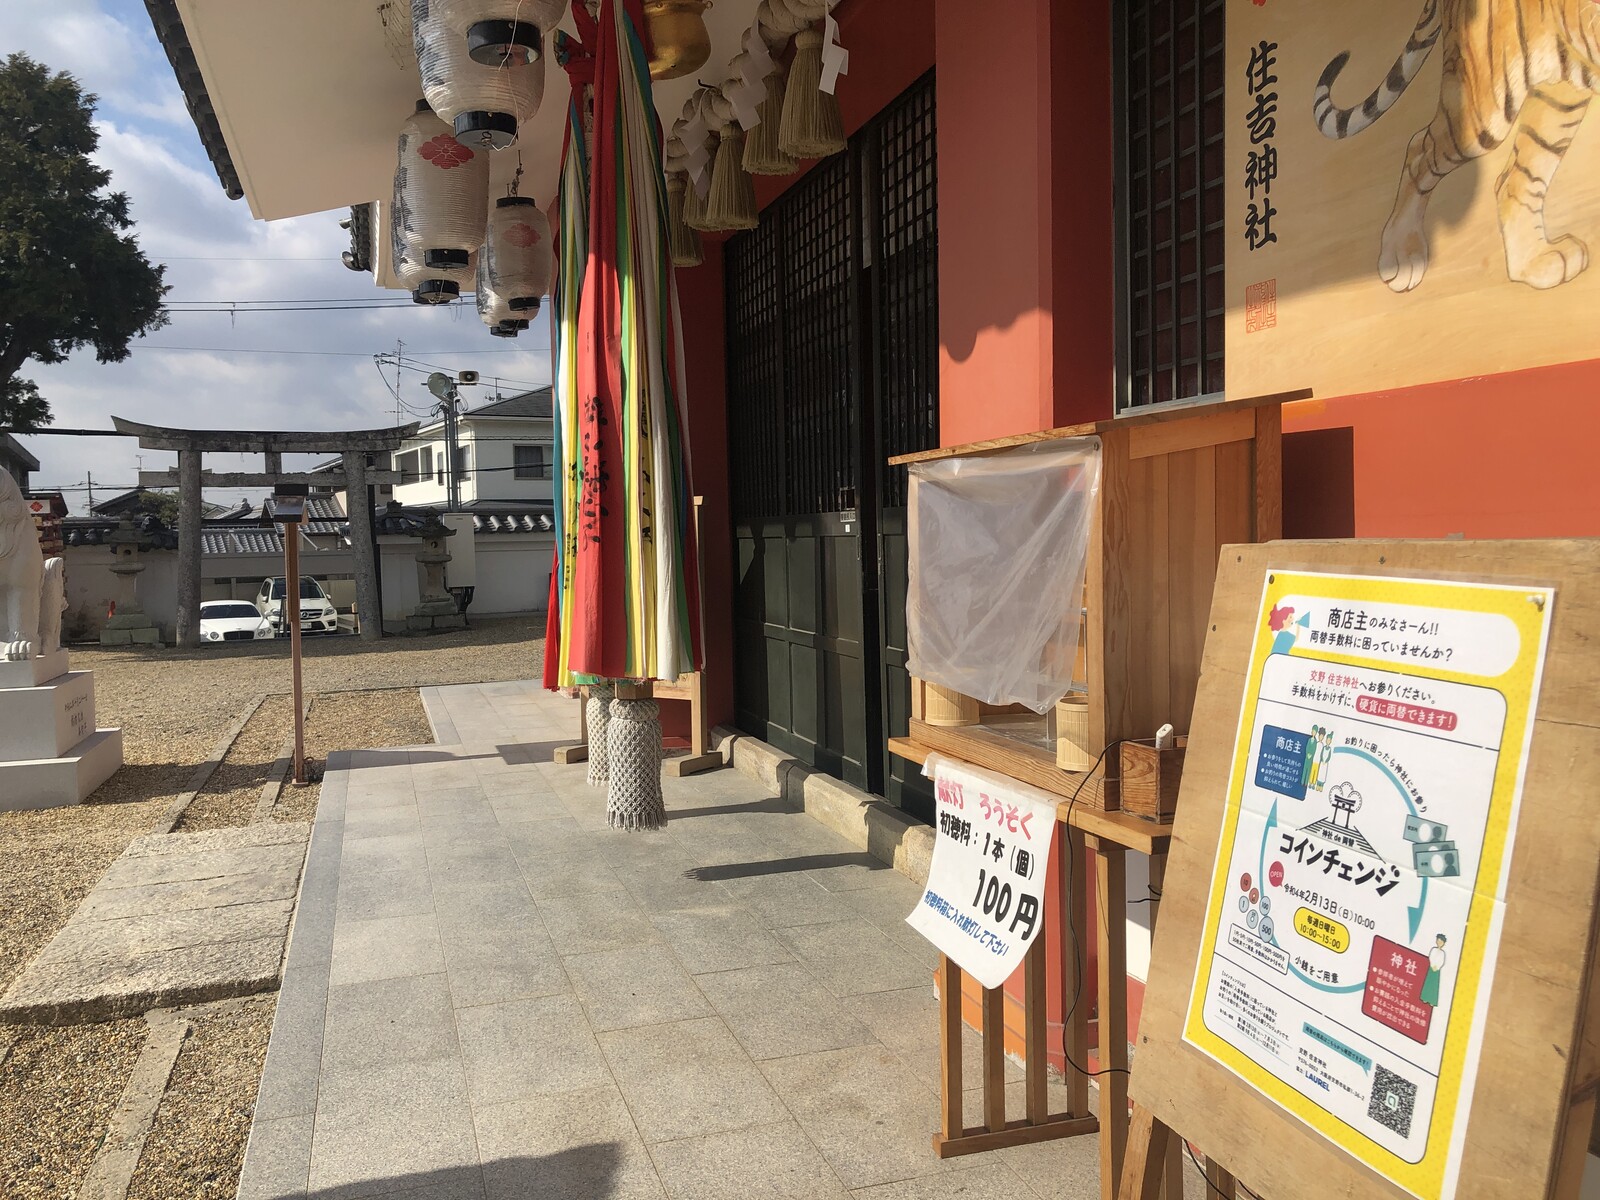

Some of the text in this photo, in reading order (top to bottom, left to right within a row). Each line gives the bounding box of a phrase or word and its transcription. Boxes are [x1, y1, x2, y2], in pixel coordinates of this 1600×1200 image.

[1245, 40, 1278, 251] 住吉神社
[1328, 607, 1439, 635] 商店主のみなさーん!!
[1310, 630, 1453, 661] 両替手数料に困っていませんか?
[1309, 670, 1325, 682] 交野
[1276, 736, 1301, 753] 商店主
[979, 792, 1034, 841] ろうそく
[1322, 829, 1333, 840] 神社
[1334, 834, 1341, 842] de
[1280, 833, 1400, 897] コインチェンジ
[972, 868, 1039, 941] 100円
[1261, 924, 1271, 935] 500
[1307, 914, 1336, 935] 毎週日曜日
[1295, 955, 1339, 984] 小銭をご用意
[1391, 952, 1417, 976] 神社
[1305, 1070, 1330, 1092] LAUREL
